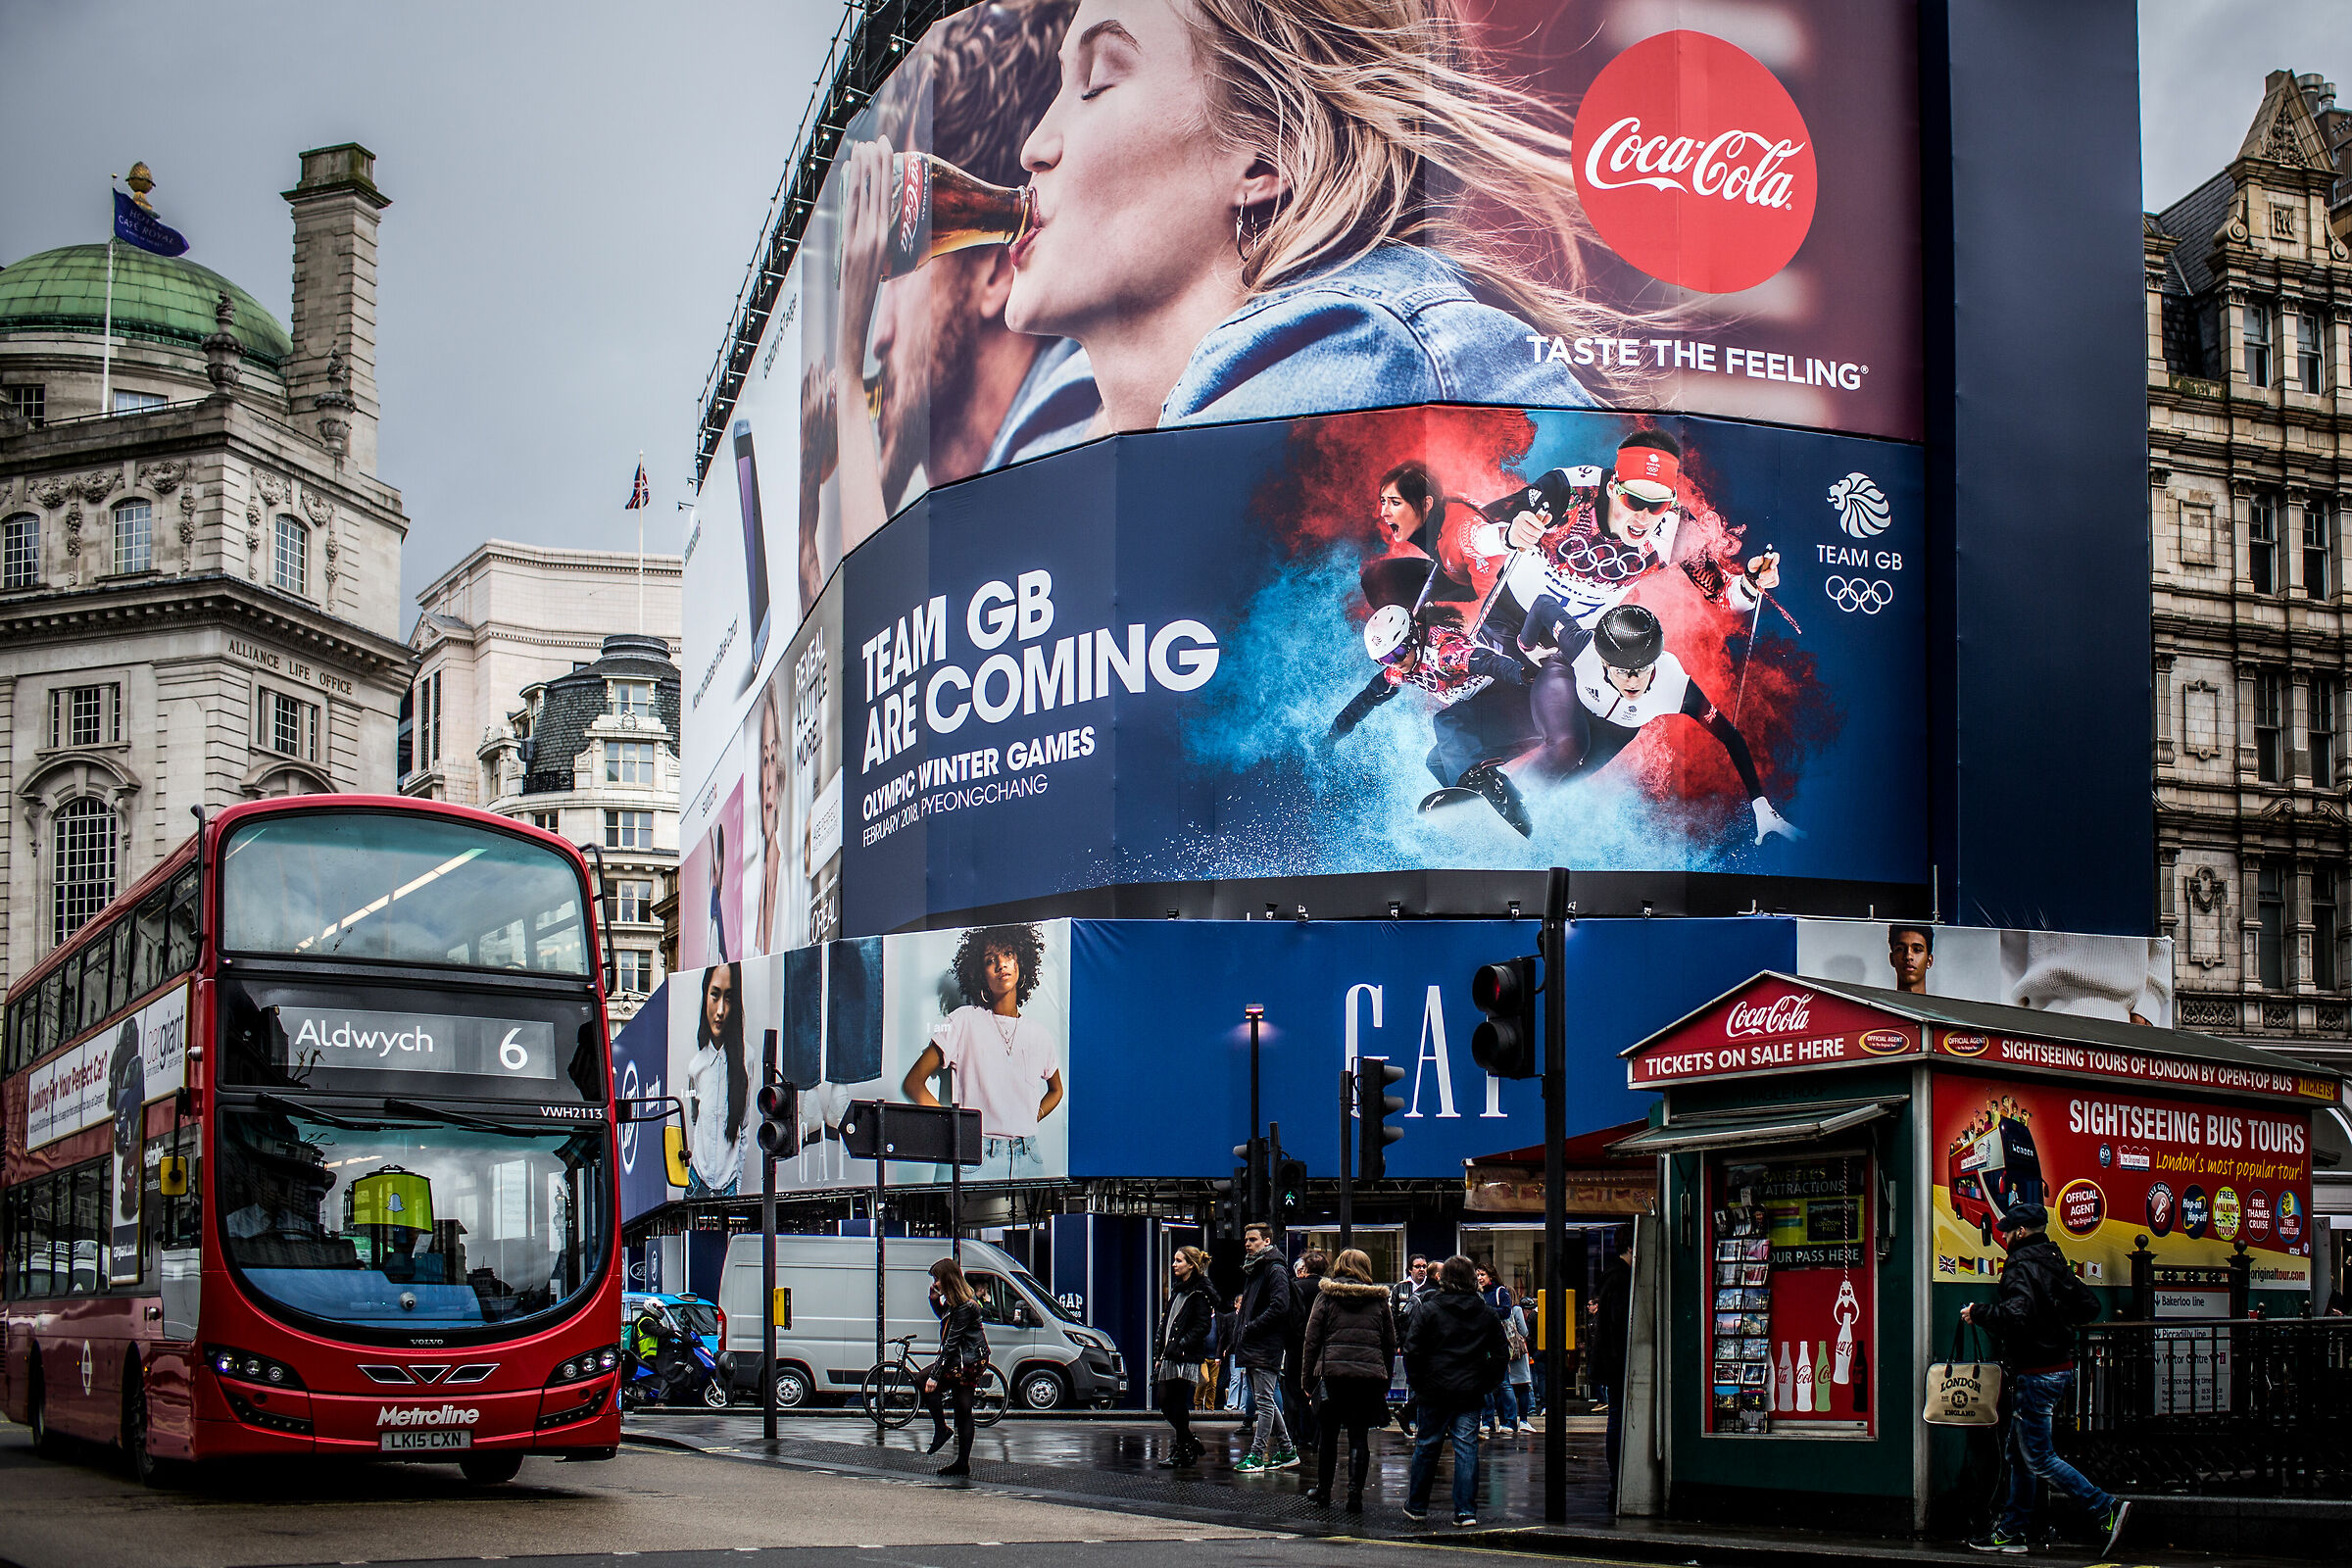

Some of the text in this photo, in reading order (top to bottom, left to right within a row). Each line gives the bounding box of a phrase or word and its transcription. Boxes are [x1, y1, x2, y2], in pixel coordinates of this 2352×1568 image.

[1585, 117, 1805, 210] Coca-Cola
[1526, 335, 1642, 367] TASTE
[1649, 339, 1717, 372] THE
[1817, 544, 1903, 570] TEAM GB
[861, 569, 1055, 703] TEAM GB
[228, 639, 353, 695] ALLIANCE LIFE OFFICE
[795, 626, 826, 697] REVEAL
[797, 662, 827, 736] A LITTLE
[861, 619, 1220, 775] ARE COMING
[862, 768, 915, 821] OLYMPIC
[918, 747, 1000, 800] WINTER
[1006, 725, 1096, 771] GAMES
[862, 810, 901, 848] FEBRUARY
[921, 773, 1049, 818] PYEONGCHANG
[1726, 994, 1815, 1037] Coca-Cola
[934, 1024, 951, 1033] am
[295, 1018, 434, 1057] Aldwych
[499, 1028, 528, 1070] 6
[1645, 1038, 1844, 1076] TICKETS ON SALE HERE
[2002, 1039, 2292, 1093] SIGHTSEEING TOURS OF LONDON BY OPEN-TOP BUS
[29, 1084, 49, 1115] Looking
[59, 1073, 72, 1099] Your
[72, 1059, 93, 1094] Perfect
[93, 1050, 108, 1082] Car?
[2300, 1078, 2332, 1097] TICKETS
[540, 1105, 603, 1119] VWH2113
[2069, 1099, 2305, 1154] SIGHTSEEING BUS TOURS
[2156, 1151, 2304, 1183] London's most popular tour!
[1764, 1169, 1792, 1183] SAVE
[1766, 1180, 1846, 1196] ATTRACTIONS
[2157, 1184, 2174, 1202] GUIDES
[2219, 1191, 2234, 1200] FREE
[2066, 1190, 2098, 1203] OFFICIAL
[2182, 1198, 2202, 1210] Hop-on
[2252, 1199, 2265, 1207] FREE
[2071, 1203, 2095, 1216] AGENT
[2215, 1202, 2238, 1213] WALKING
[2247, 1209, 2270, 1219] THAMES
[2187, 1211, 2208, 1224] Hop-off
[2249, 1220, 2268, 1229] CRUISE
[2218, 1226, 2234, 1236] TOURS
[1768, 1249, 1859, 1263] OUR PASS HERE
[2250, 1267, 2306, 1282] originaltour.com
[1058, 1293, 1083, 1309] GAP
[2162, 1296, 2205, 1306] Bakerloo line
[2162, 1329, 2193, 1338] Piccadilly
[2162, 1352, 2208, 1364] Vtor Cntre
[1940, 1378, 1981, 1394] LONDON
[376, 1404, 480, 1426] Metroline
[391, 1432, 462, 1448] LK15 CXN
